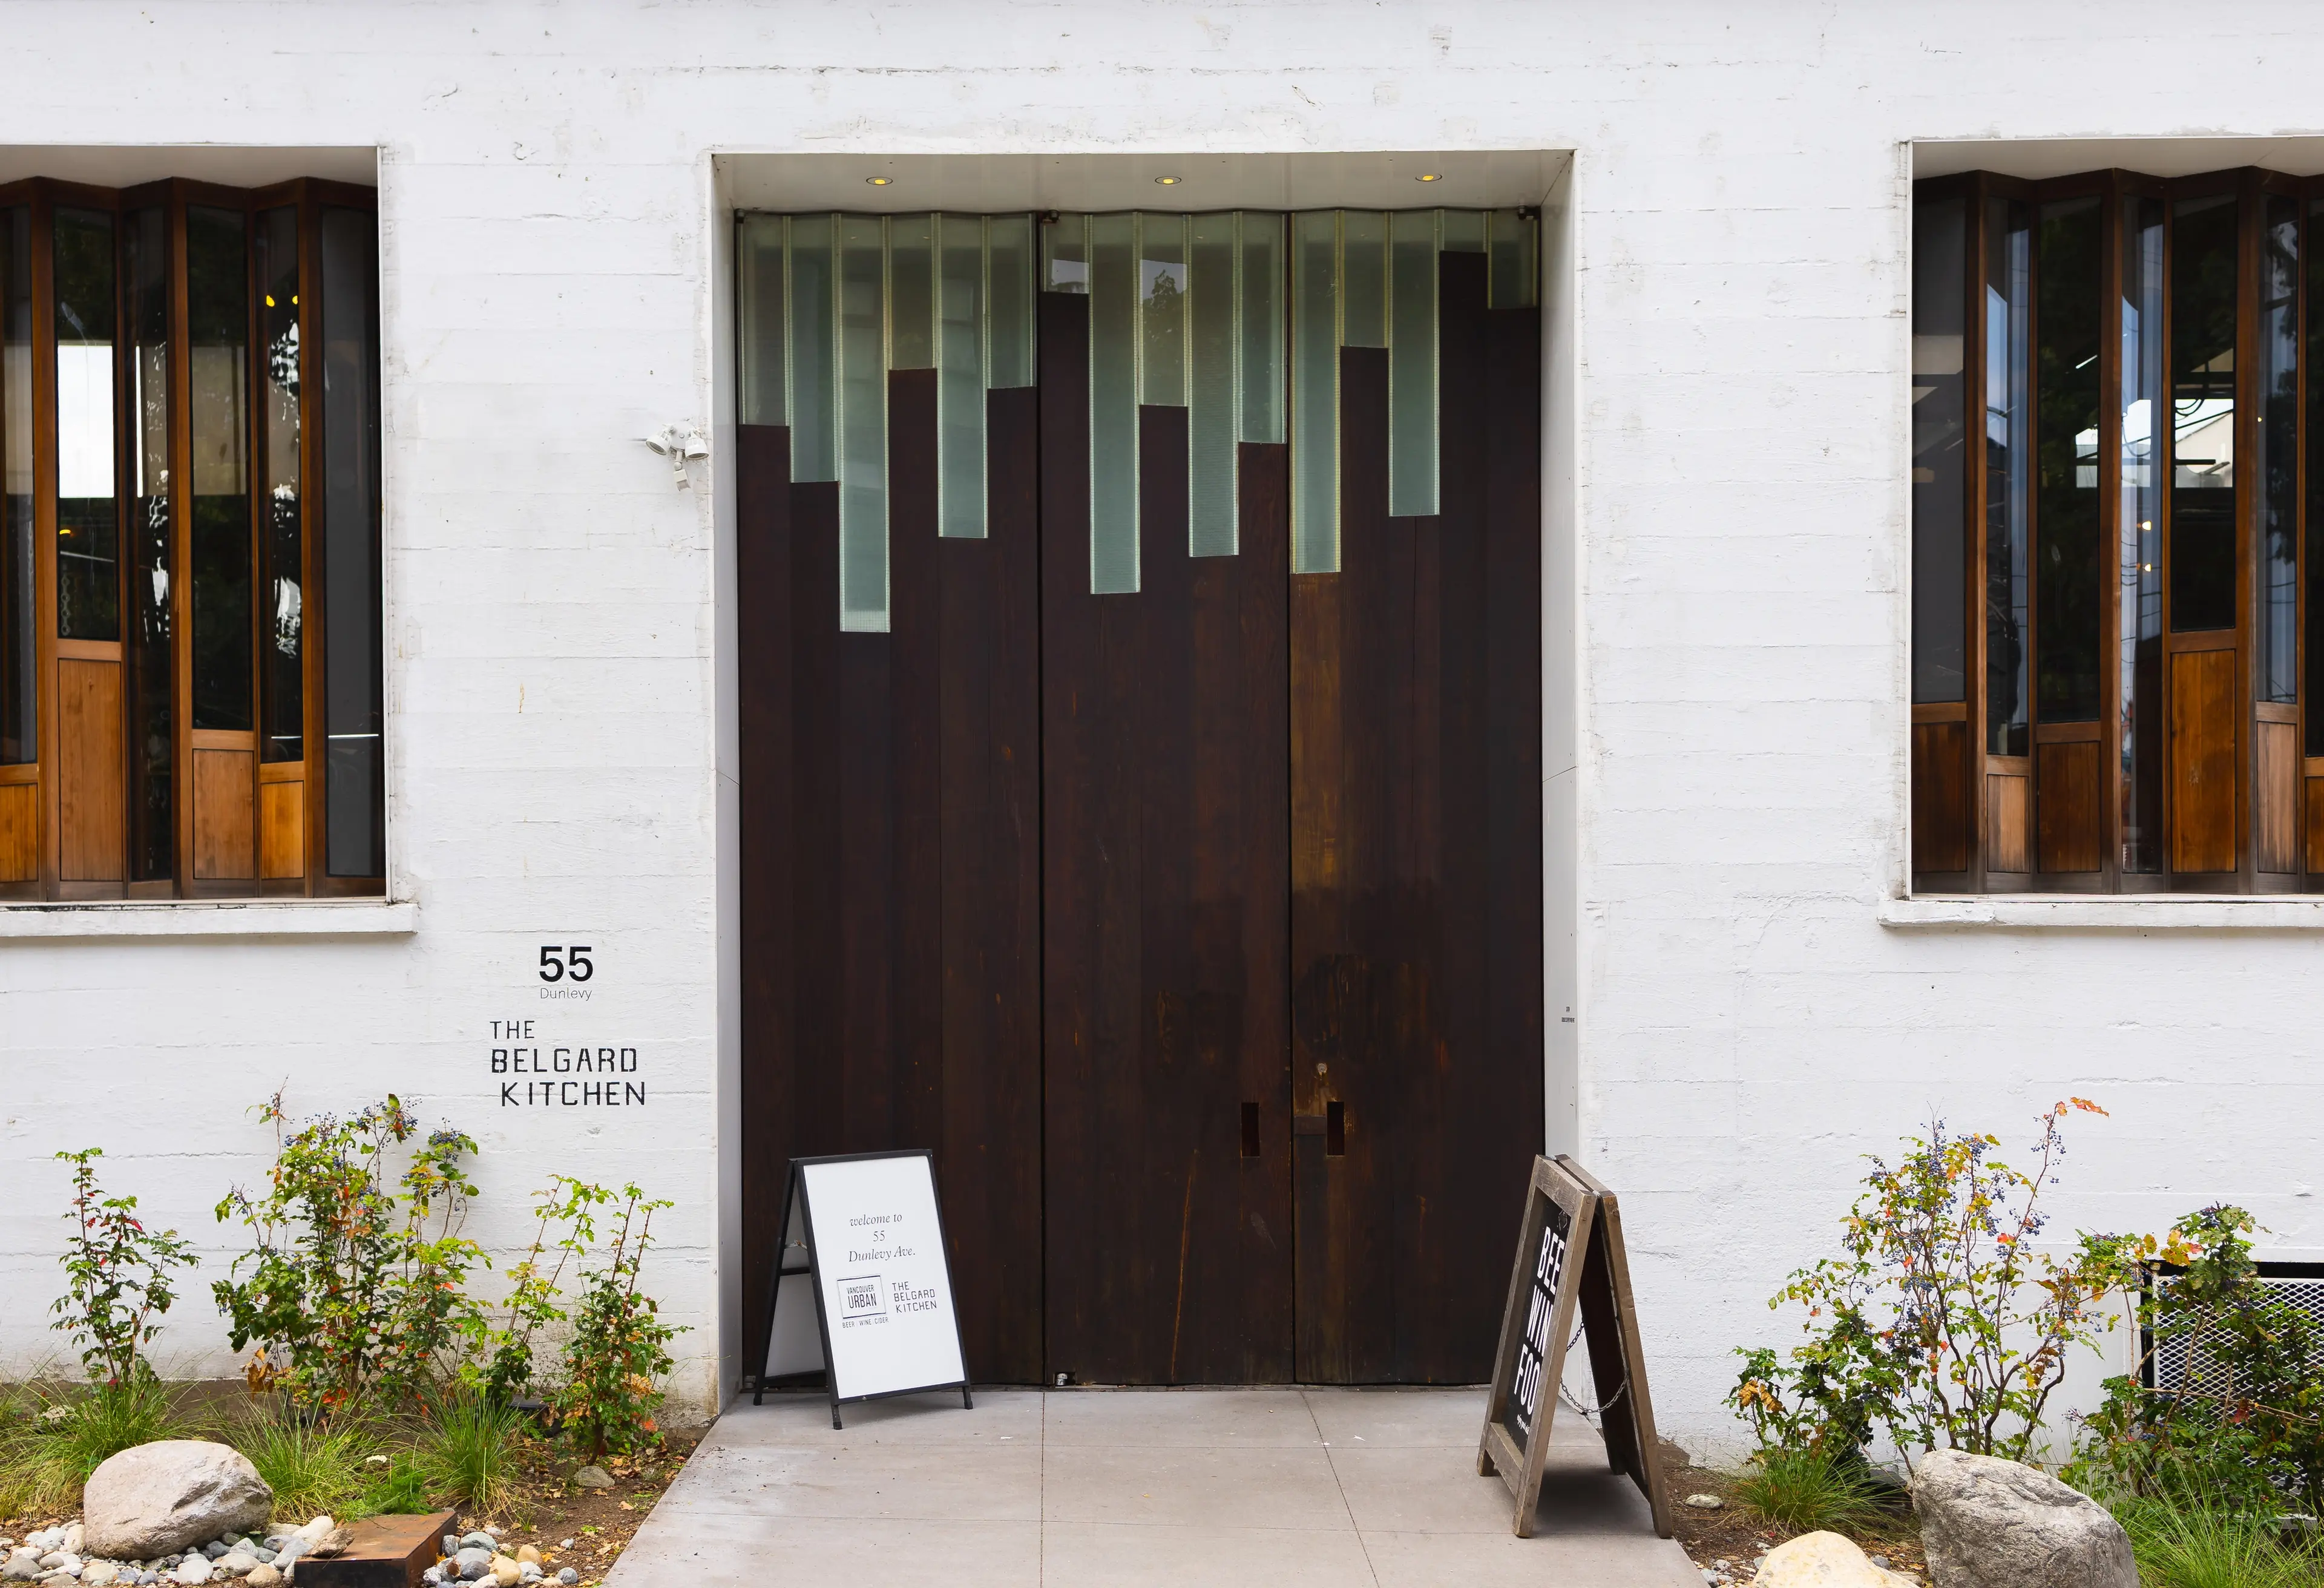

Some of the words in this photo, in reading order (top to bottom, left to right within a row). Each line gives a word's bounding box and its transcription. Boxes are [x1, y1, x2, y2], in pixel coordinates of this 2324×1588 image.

[539, 946, 594, 982] 55
[540, 987, 592, 1002] Dunlevy
[490, 1020, 535, 1039] THE
[491, 1048, 637, 1074] BELGARD
[502, 1081, 645, 1107] KITCHEN
[850, 1214, 890, 1226] welcome
[894, 1213, 902, 1222] to
[873, 1230, 885, 1242] 55
[849, 1248, 891, 1262] Dunlevy
[894, 1245, 916, 1257] Ave.
[1537, 1225, 1566, 1296] BEE
[847, 1284, 875, 1294] VANCOUVER
[891, 1281, 910, 1291] THE
[848, 1293, 877, 1308] URBAN
[894, 1288, 935, 1302] BELGARD
[896, 1300, 937, 1313] KITCHEN
[1526, 1284, 1554, 1357] WIN
[1514, 1343, 1541, 1416] FOO
